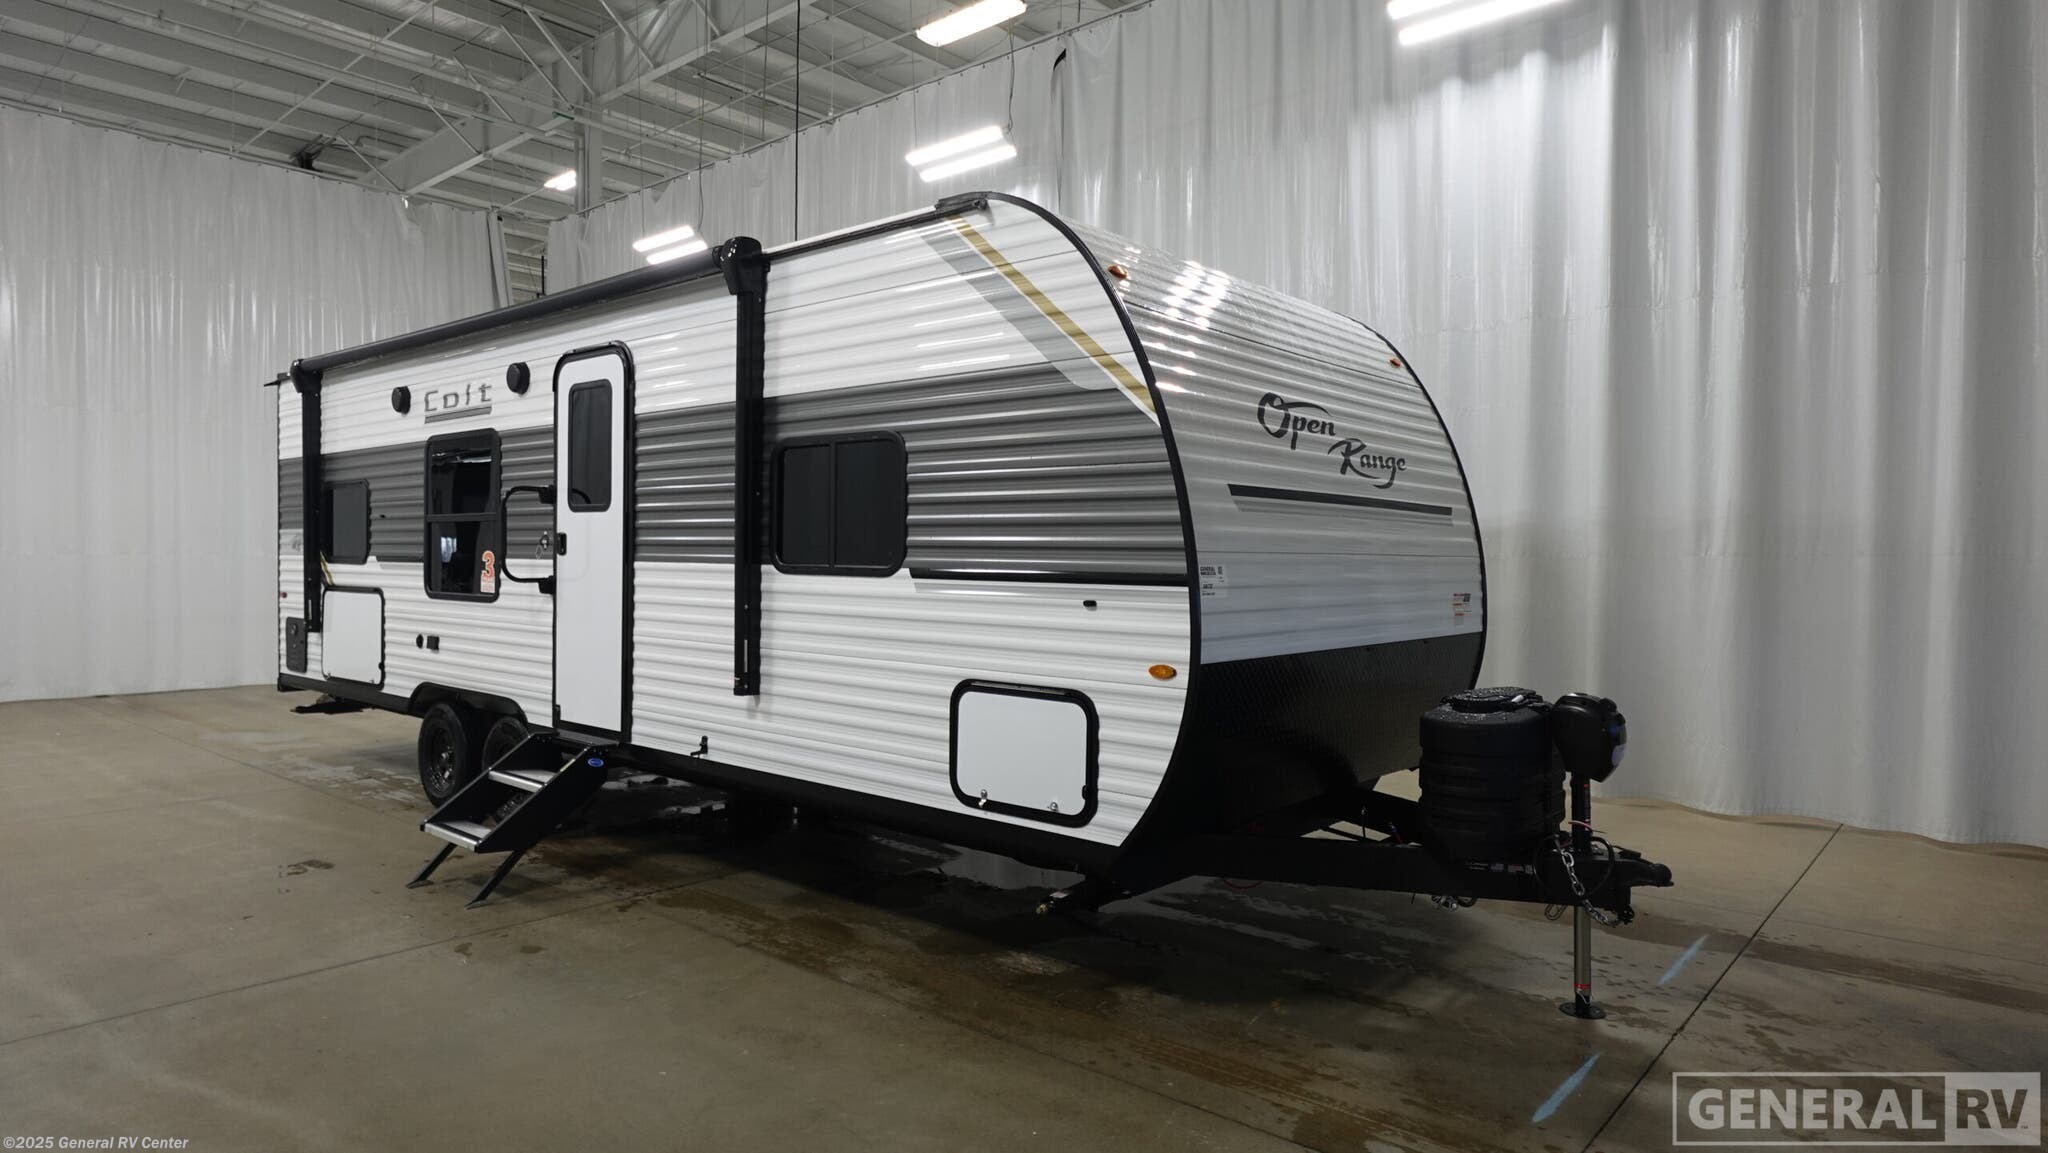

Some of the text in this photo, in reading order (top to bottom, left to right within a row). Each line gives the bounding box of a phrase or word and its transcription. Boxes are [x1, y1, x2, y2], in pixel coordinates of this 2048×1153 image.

[424, 383, 493, 412] Colt
[1256, 391, 1337, 451] Open
[1327, 437, 1407, 490] Range
[482, 550, 496, 579] 3
